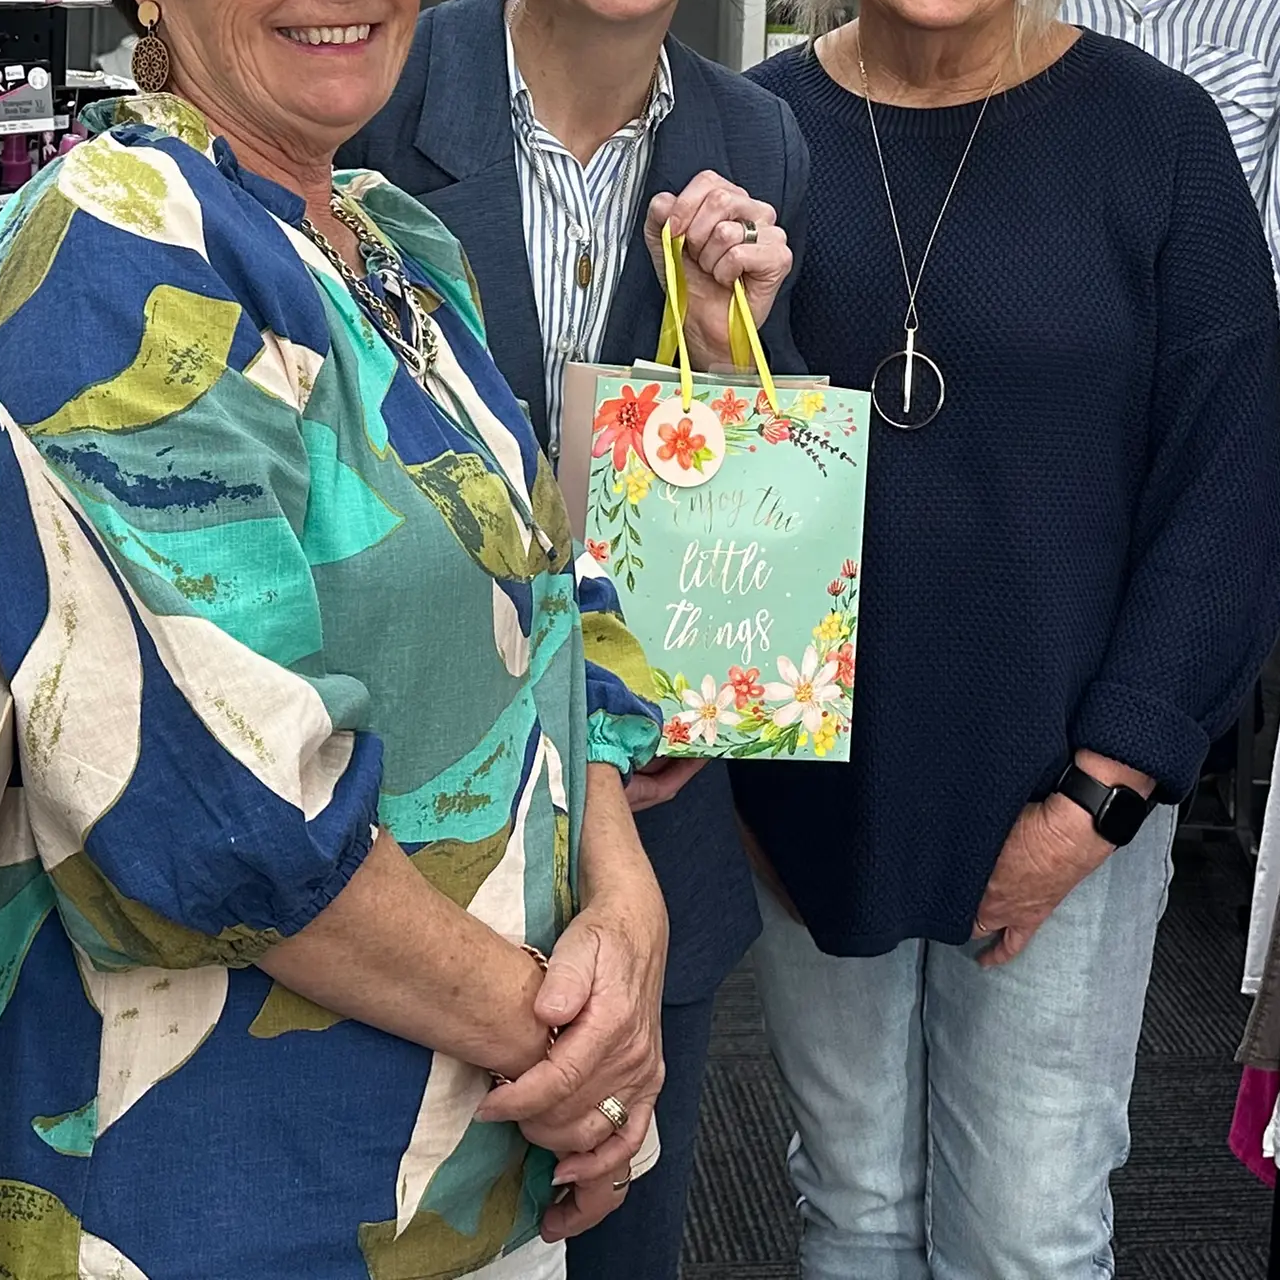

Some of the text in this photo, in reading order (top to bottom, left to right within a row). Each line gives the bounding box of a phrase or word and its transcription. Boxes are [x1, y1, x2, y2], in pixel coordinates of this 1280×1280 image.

[753, 483, 803, 534] the
[679, 538, 774, 596] little
[663, 597, 775, 666] things
